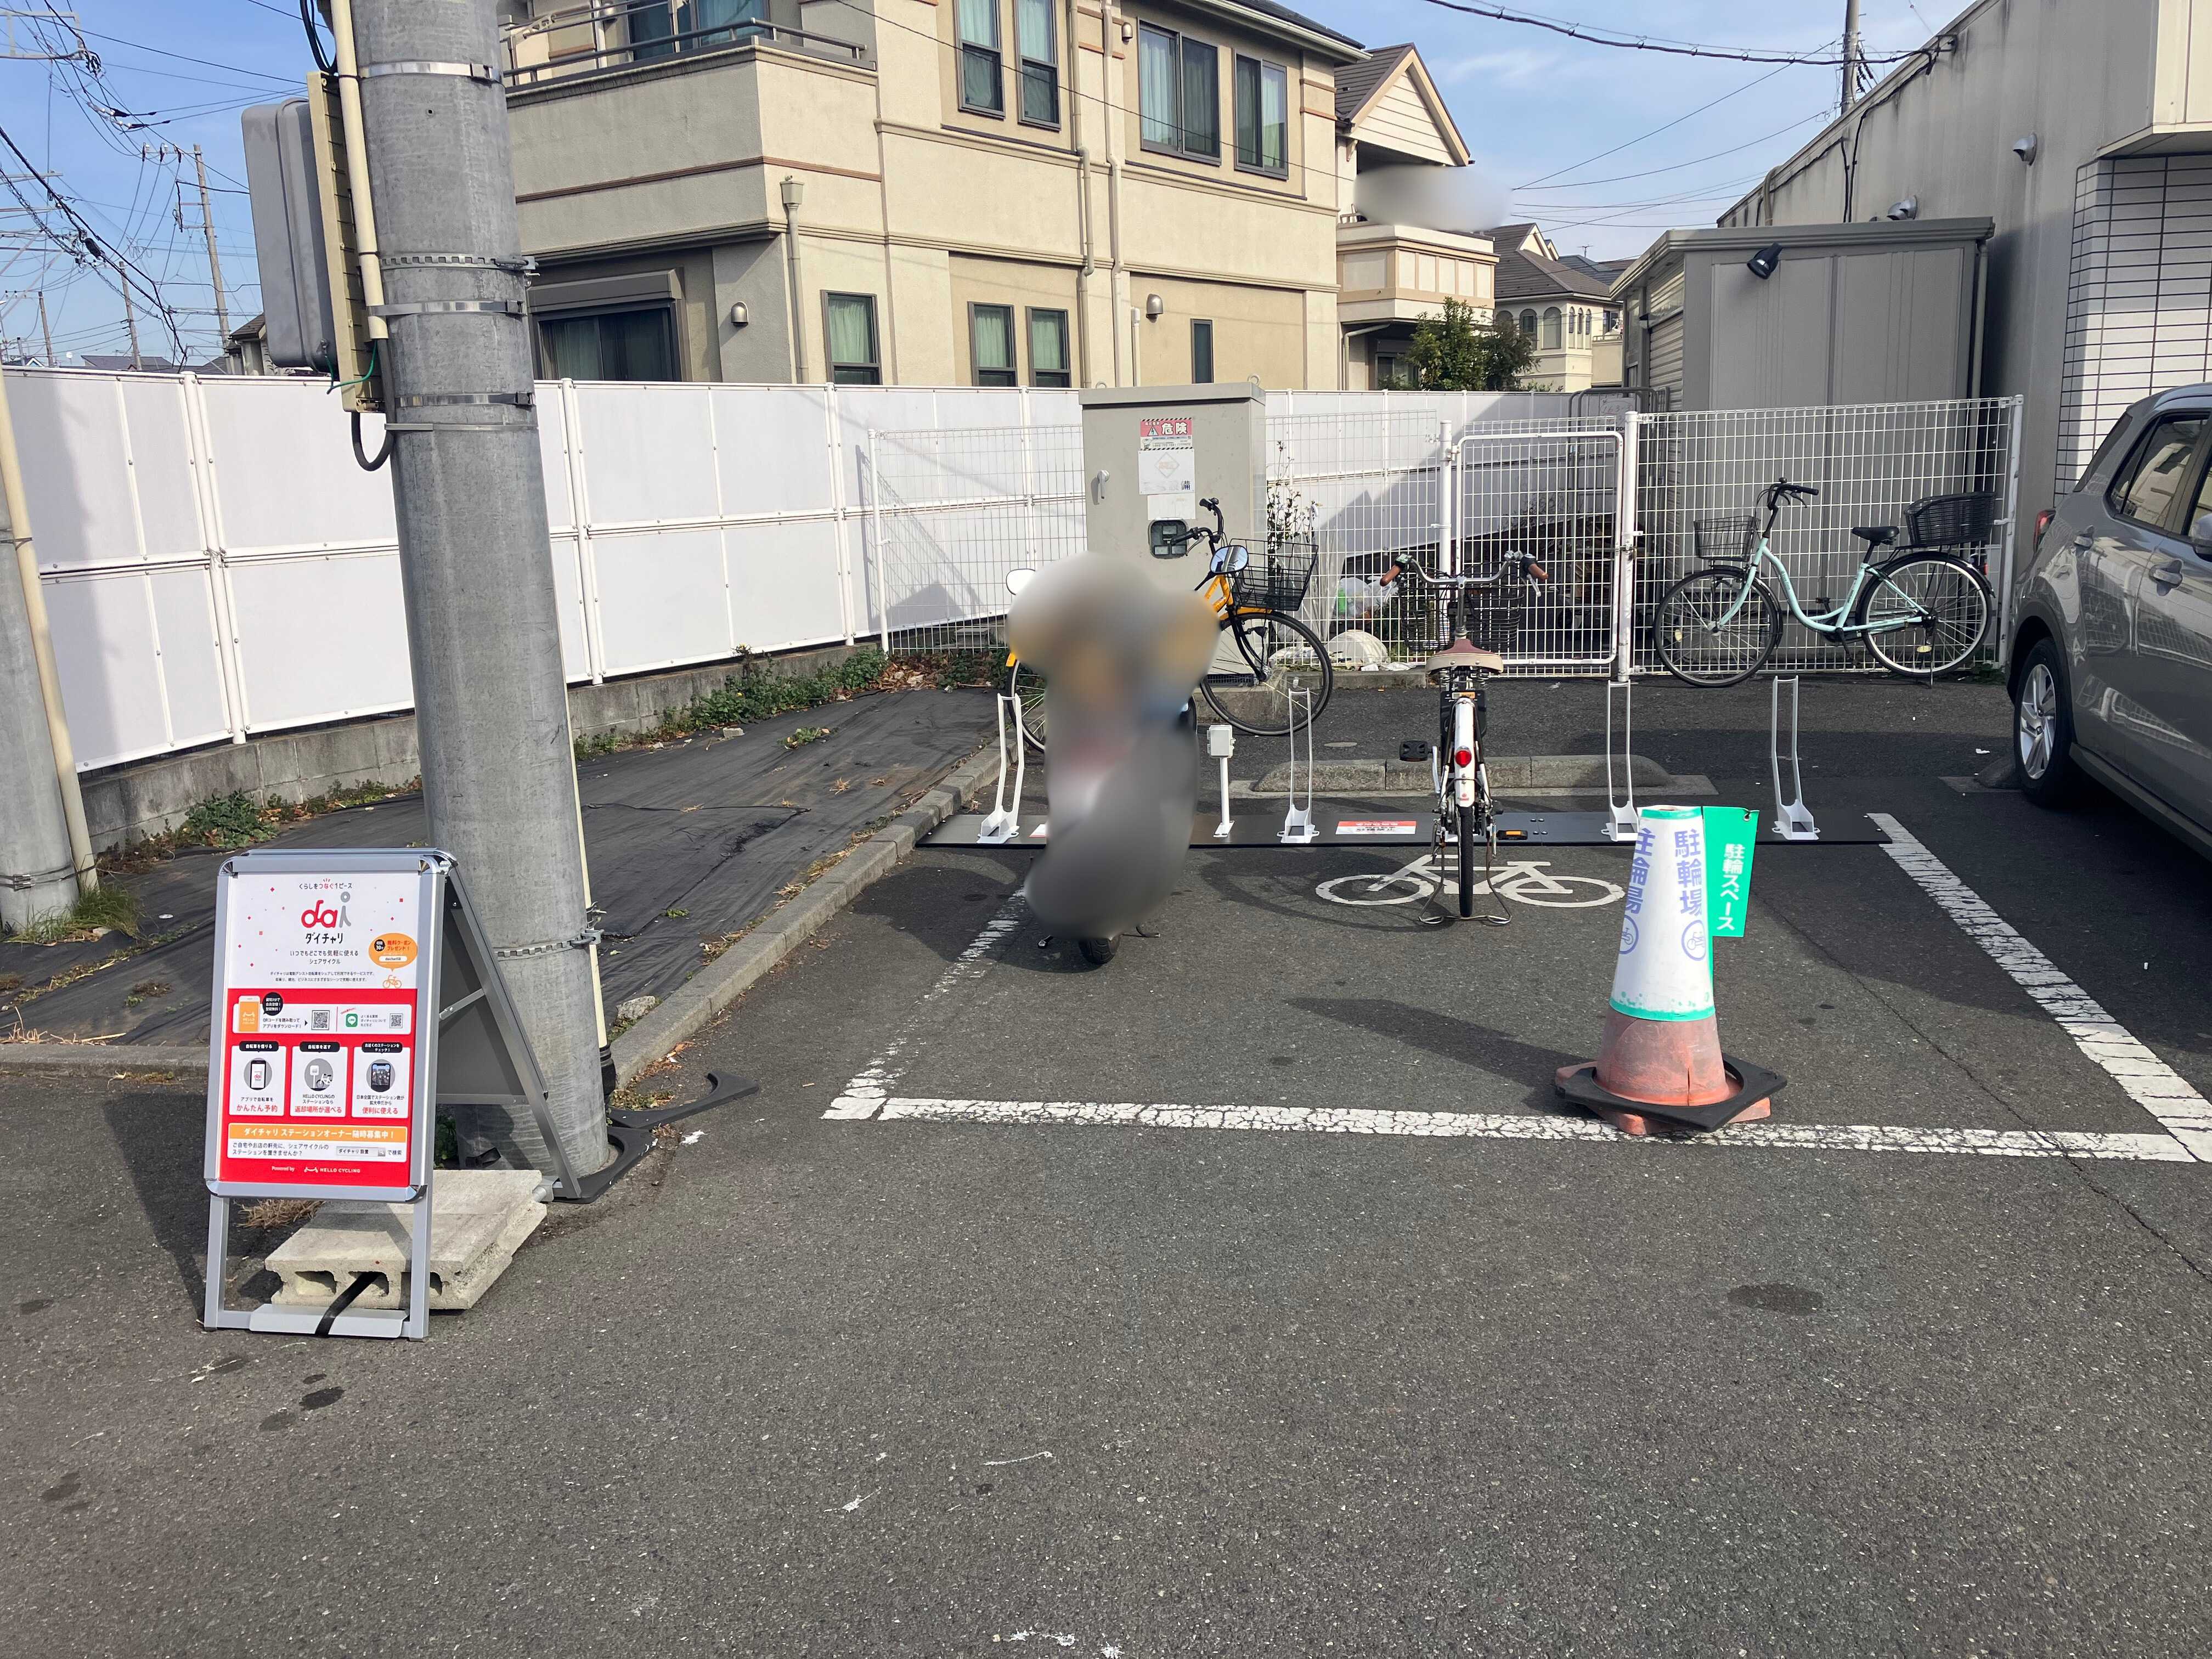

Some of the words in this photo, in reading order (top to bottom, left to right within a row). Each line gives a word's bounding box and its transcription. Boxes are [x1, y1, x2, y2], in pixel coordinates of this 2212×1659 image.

[1161, 422, 1188, 435] 危険
[1674, 828, 1702, 916] 駐輪場
[1717, 843, 1746, 931] 駐輪スペース
[301, 891, 352, 928] dai
[306, 932, 343, 944] ダイチャリ
[295, 1105, 342, 1114] 返却場所が選べる
[233, 1142, 329, 1150] ご自宅やお店の軒先に、シェアサイクルの
